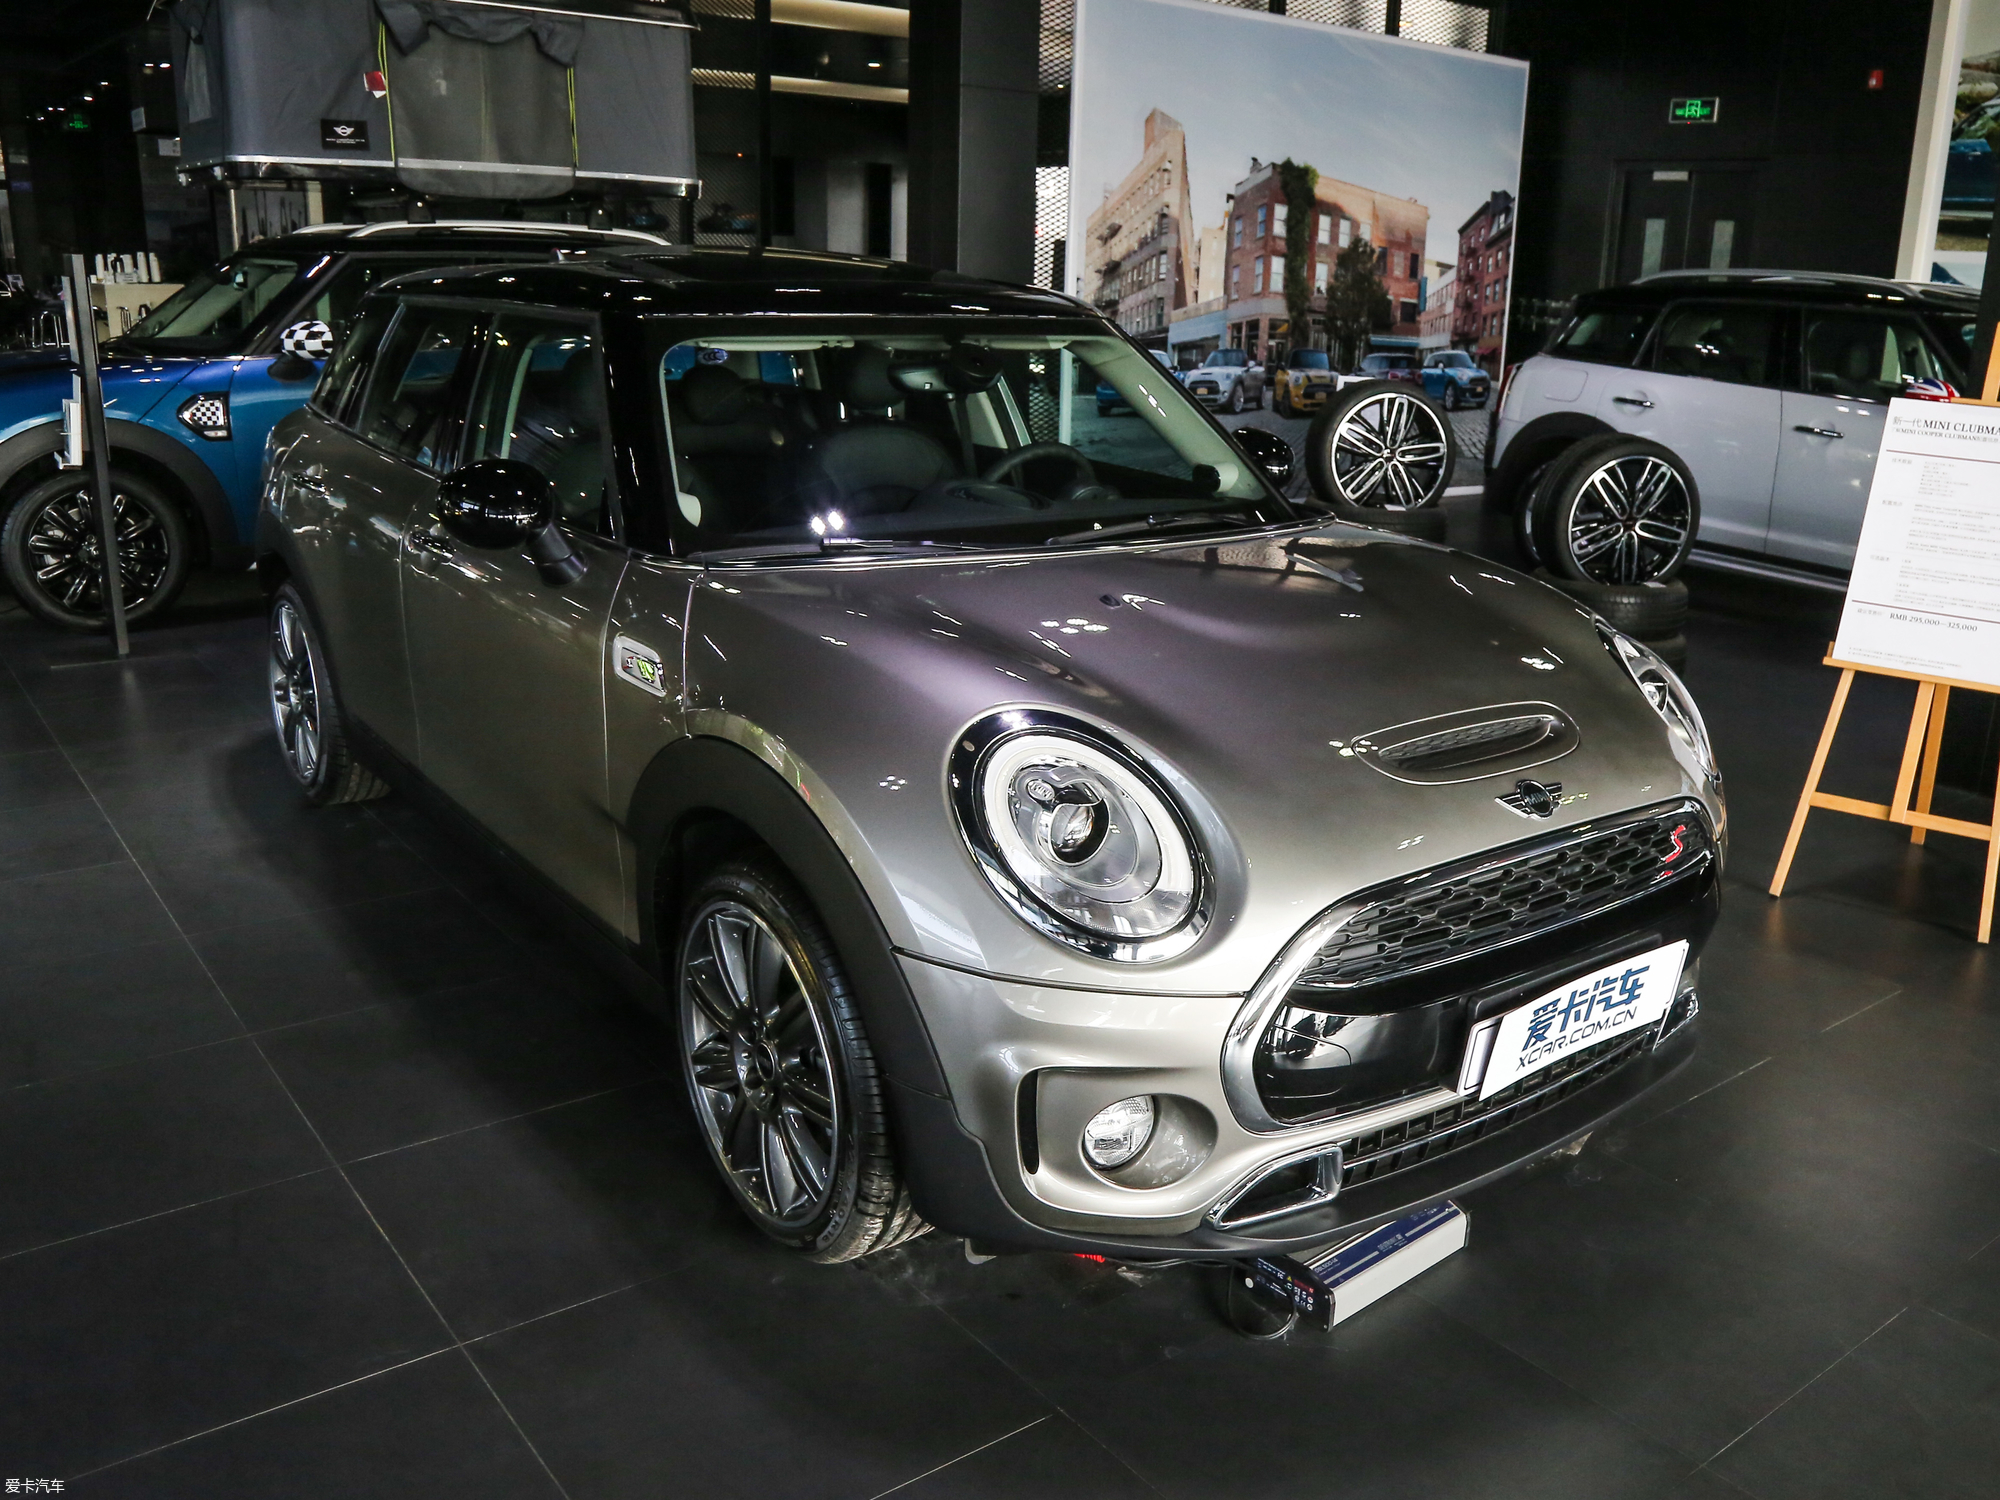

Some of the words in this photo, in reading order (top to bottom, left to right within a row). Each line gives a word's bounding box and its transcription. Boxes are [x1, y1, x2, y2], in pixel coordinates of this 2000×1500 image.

[1890, 612, 1908, 621] RMB
[1659, 824, 1687, 863] S
[1521, 965, 1651, 1051] 爱卡汽车
[1515, 1006, 1638, 1071] XCAR.COM.CN
